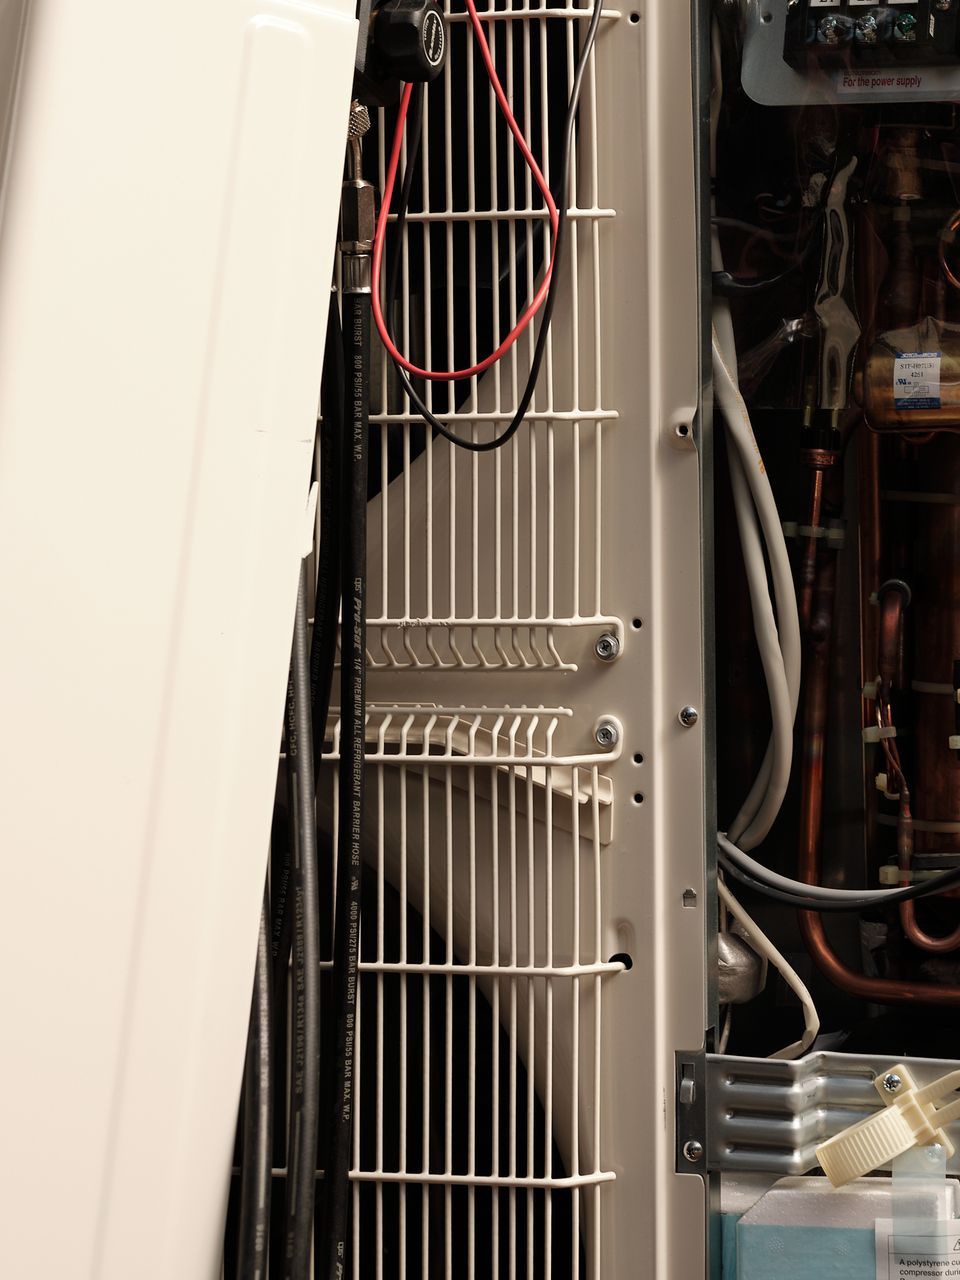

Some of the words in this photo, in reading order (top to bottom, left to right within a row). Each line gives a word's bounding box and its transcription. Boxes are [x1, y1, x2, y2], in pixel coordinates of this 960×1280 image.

[843, 77, 856, 87] For
[858, 76, 870, 86] the
[871, 78, 894, 88] power
[896, 76, 922, 88] supply
[354, 318, 362, 347] BURST
[354, 355, 362, 369] 800
[354, 371, 362, 398] PSI/55
[354, 400, 362, 418] BAR
[353, 421, 362, 442] MAX.
[353, 445, 362, 462] W.P.
[353, 658, 362, 674] 1/4"
[353, 719, 361, 735] ALL
[352, 738, 361, 796] REFRIGERANT
[352, 800, 361, 840] BARRIER
[352, 842, 360, 866] HOSE
[350, 901, 358, 920] 4000
[348, 922, 357, 953] PSI/275
[348, 955, 356, 973] BAR
[296, 968, 304, 991] SAE
[347, 976, 356, 1004] BURST
[345, 1031, 353, 1056] PSI/55
[344, 1059, 353, 1078] BAR
[295, 1071, 303, 1093] SAE
[343, 1080, 352, 1102] MAX.
[342, 1104, 351, 1122] W.P.
[900, 1269, 943, 1277] compressor
[906, 1259, 950, 1268] polystyrene
